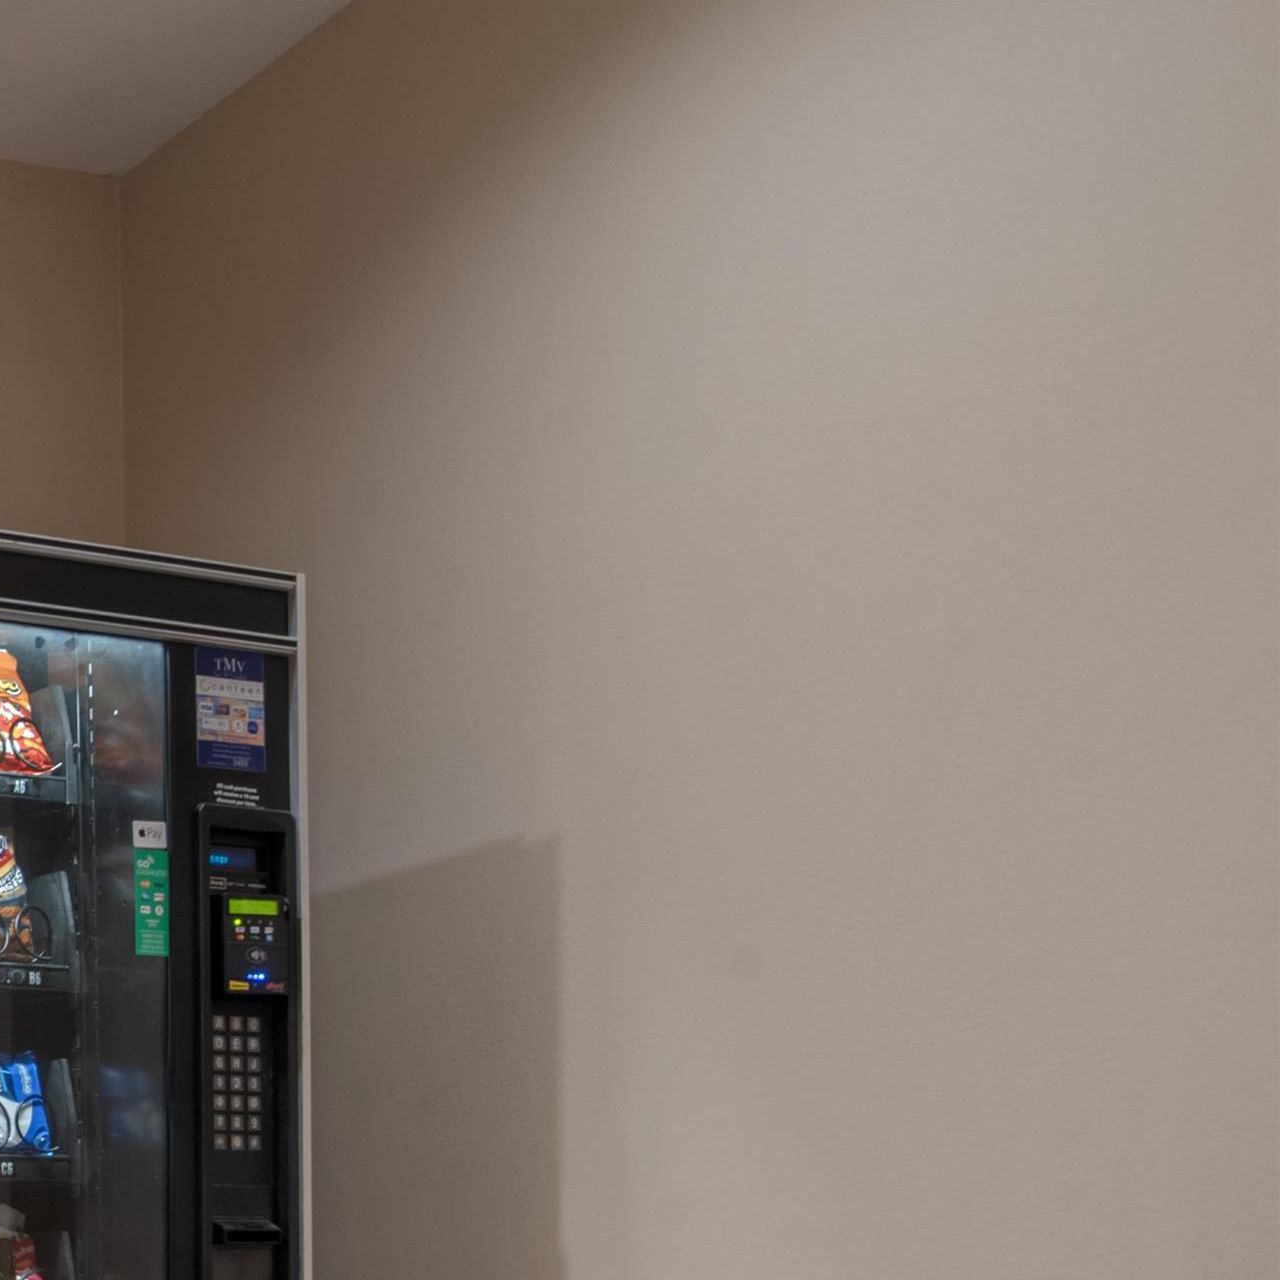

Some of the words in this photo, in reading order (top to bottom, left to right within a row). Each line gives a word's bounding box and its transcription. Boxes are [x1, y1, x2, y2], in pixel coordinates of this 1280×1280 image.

[147, 827, 162, 839] Pay
[29, 971, 42, 985] B6
[1, 1162, 14, 1176] C6
